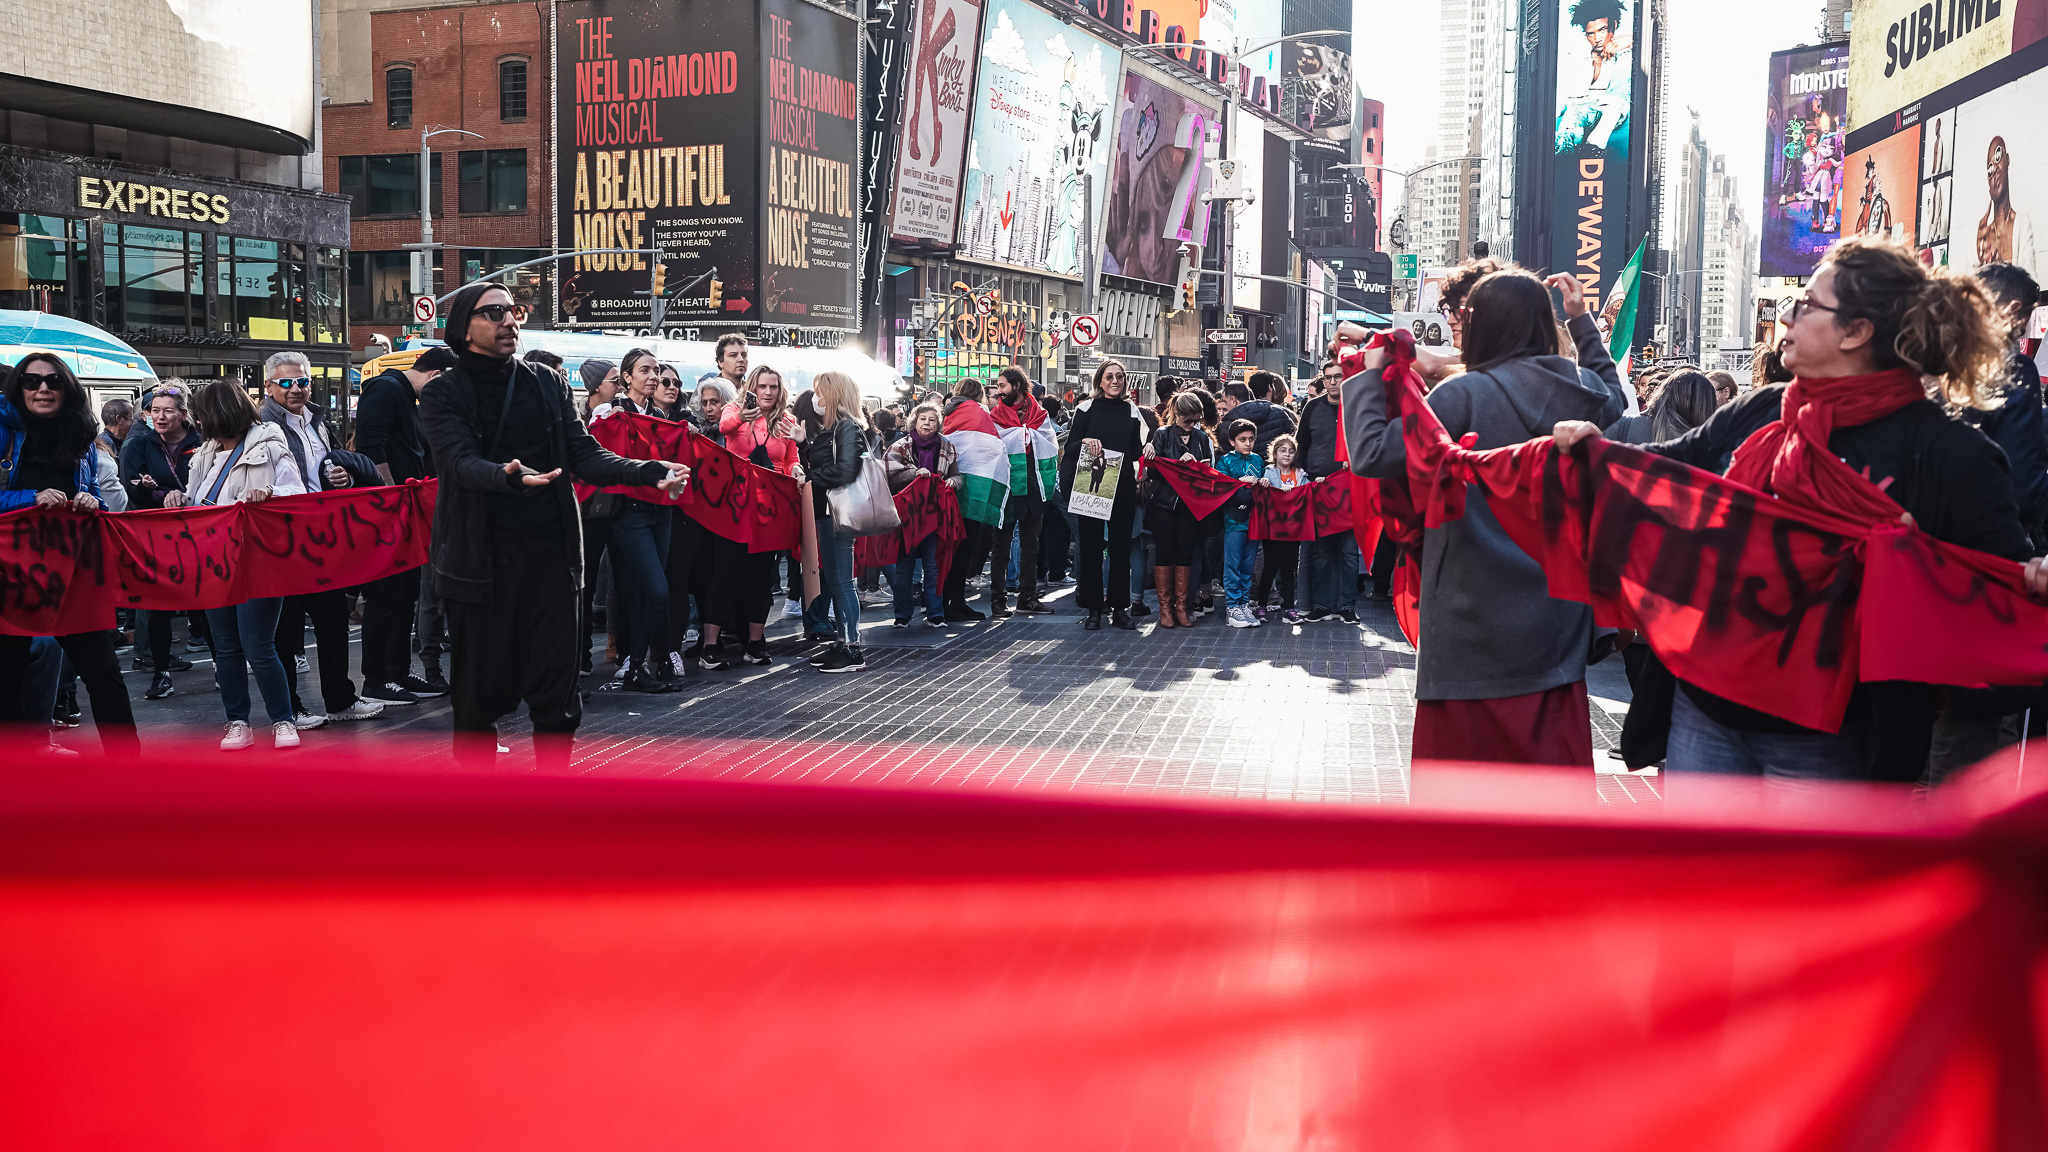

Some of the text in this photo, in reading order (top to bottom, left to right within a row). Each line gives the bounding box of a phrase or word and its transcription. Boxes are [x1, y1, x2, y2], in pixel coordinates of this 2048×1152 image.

[576, 17, 613, 60] THE
[769, 14, 791, 61] THE
[576, 51, 737, 103] NEIL DIAMOND
[769, 57, 856, 120] NEIL DIAMOND
[993, 73, 1030, 99] WELCOME
[576, 100, 663, 146] MUSICAL
[769, 100, 819, 151] MUSICAL
[993, 118, 1013, 135] VISIT
[79, 176, 230, 224] EXPRESS
[574, 144, 730, 211] A BEAUTIFUL
[768, 145, 853, 218] A BEAUTIFUL
[574, 211, 646, 272] NOISE
[673, 231, 697, 239] STORY
[683, 239, 711, 247] HEARD,
[768, 207, 809, 269] NOISE
[797, 330, 846, 348] LUGGAGE
